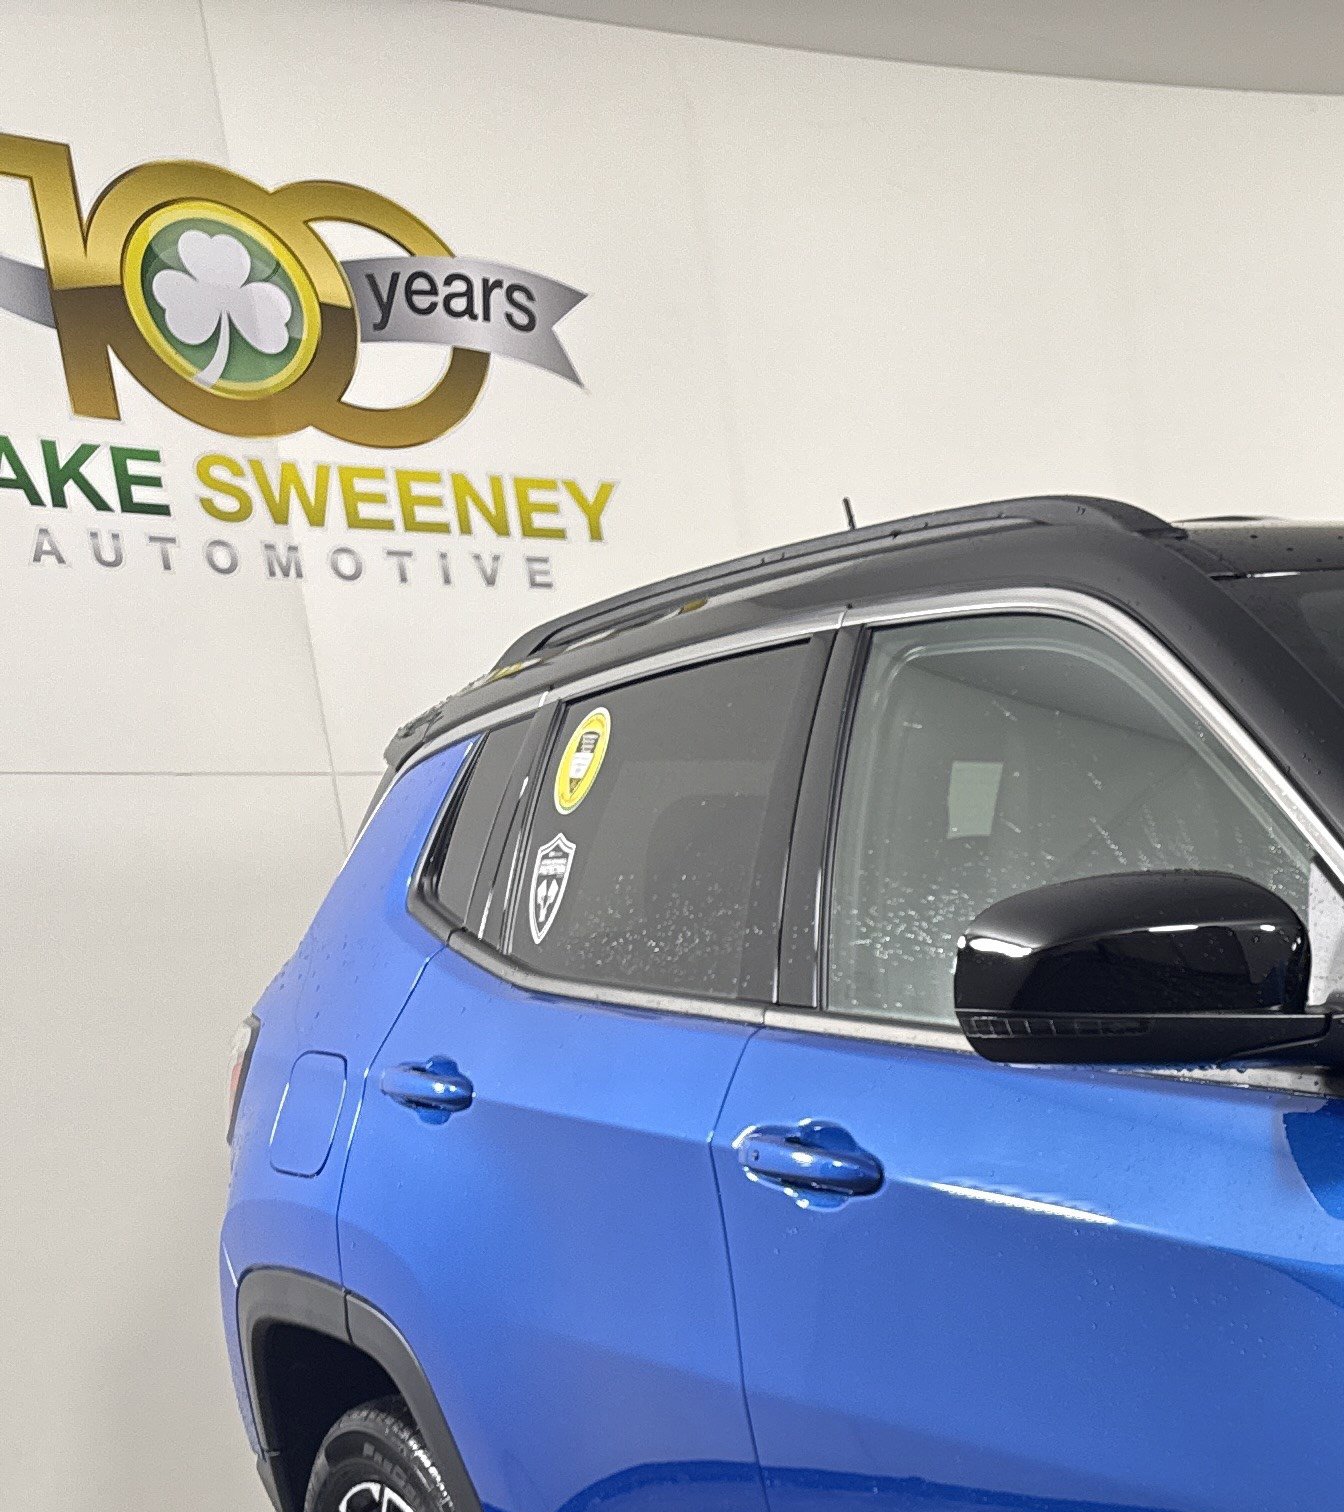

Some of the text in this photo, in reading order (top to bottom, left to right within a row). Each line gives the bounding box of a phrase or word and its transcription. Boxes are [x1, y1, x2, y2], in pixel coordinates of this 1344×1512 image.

[365, 266, 538, 333] years
[193, 452, 615, 543] SWEENEY
[31, 527, 556, 589] AUTOMOTIVE
